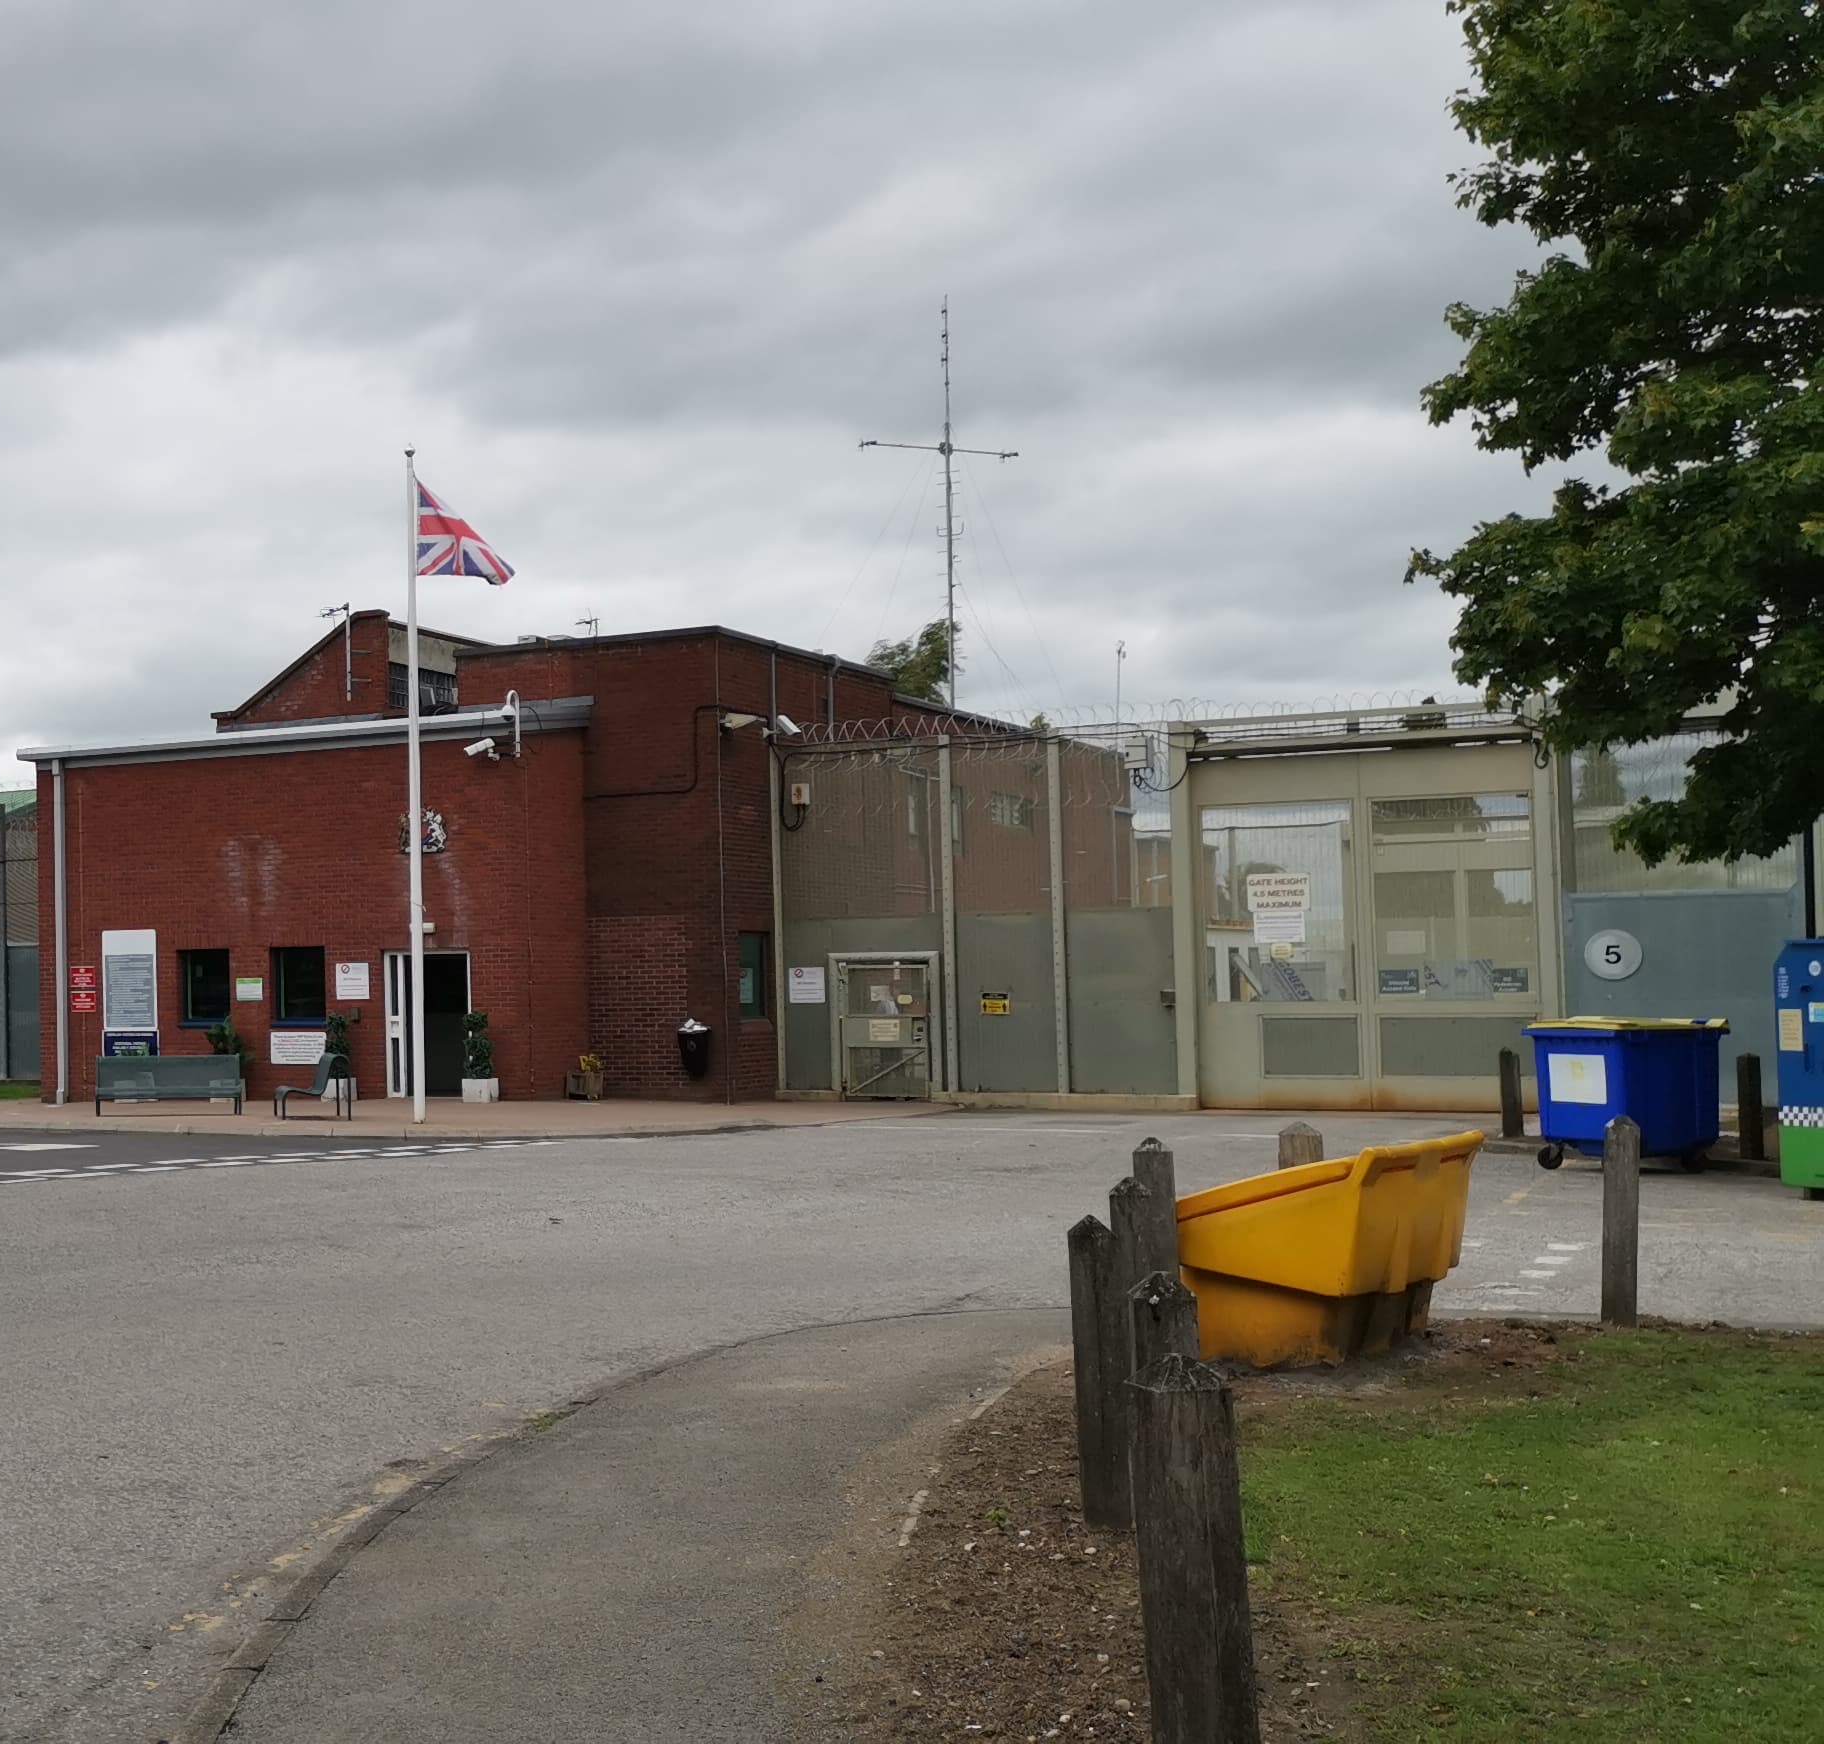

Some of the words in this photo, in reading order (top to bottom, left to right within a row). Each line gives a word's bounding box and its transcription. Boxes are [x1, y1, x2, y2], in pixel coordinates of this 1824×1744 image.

[1248, 878, 1273, 886] GATE
[1275, 877, 1308, 886] HEIGHT
[1267, 889, 1305, 897] METRES
[1256, 901, 1302, 909] MAXIMUM
[1605, 945, 1622, 964] 5
